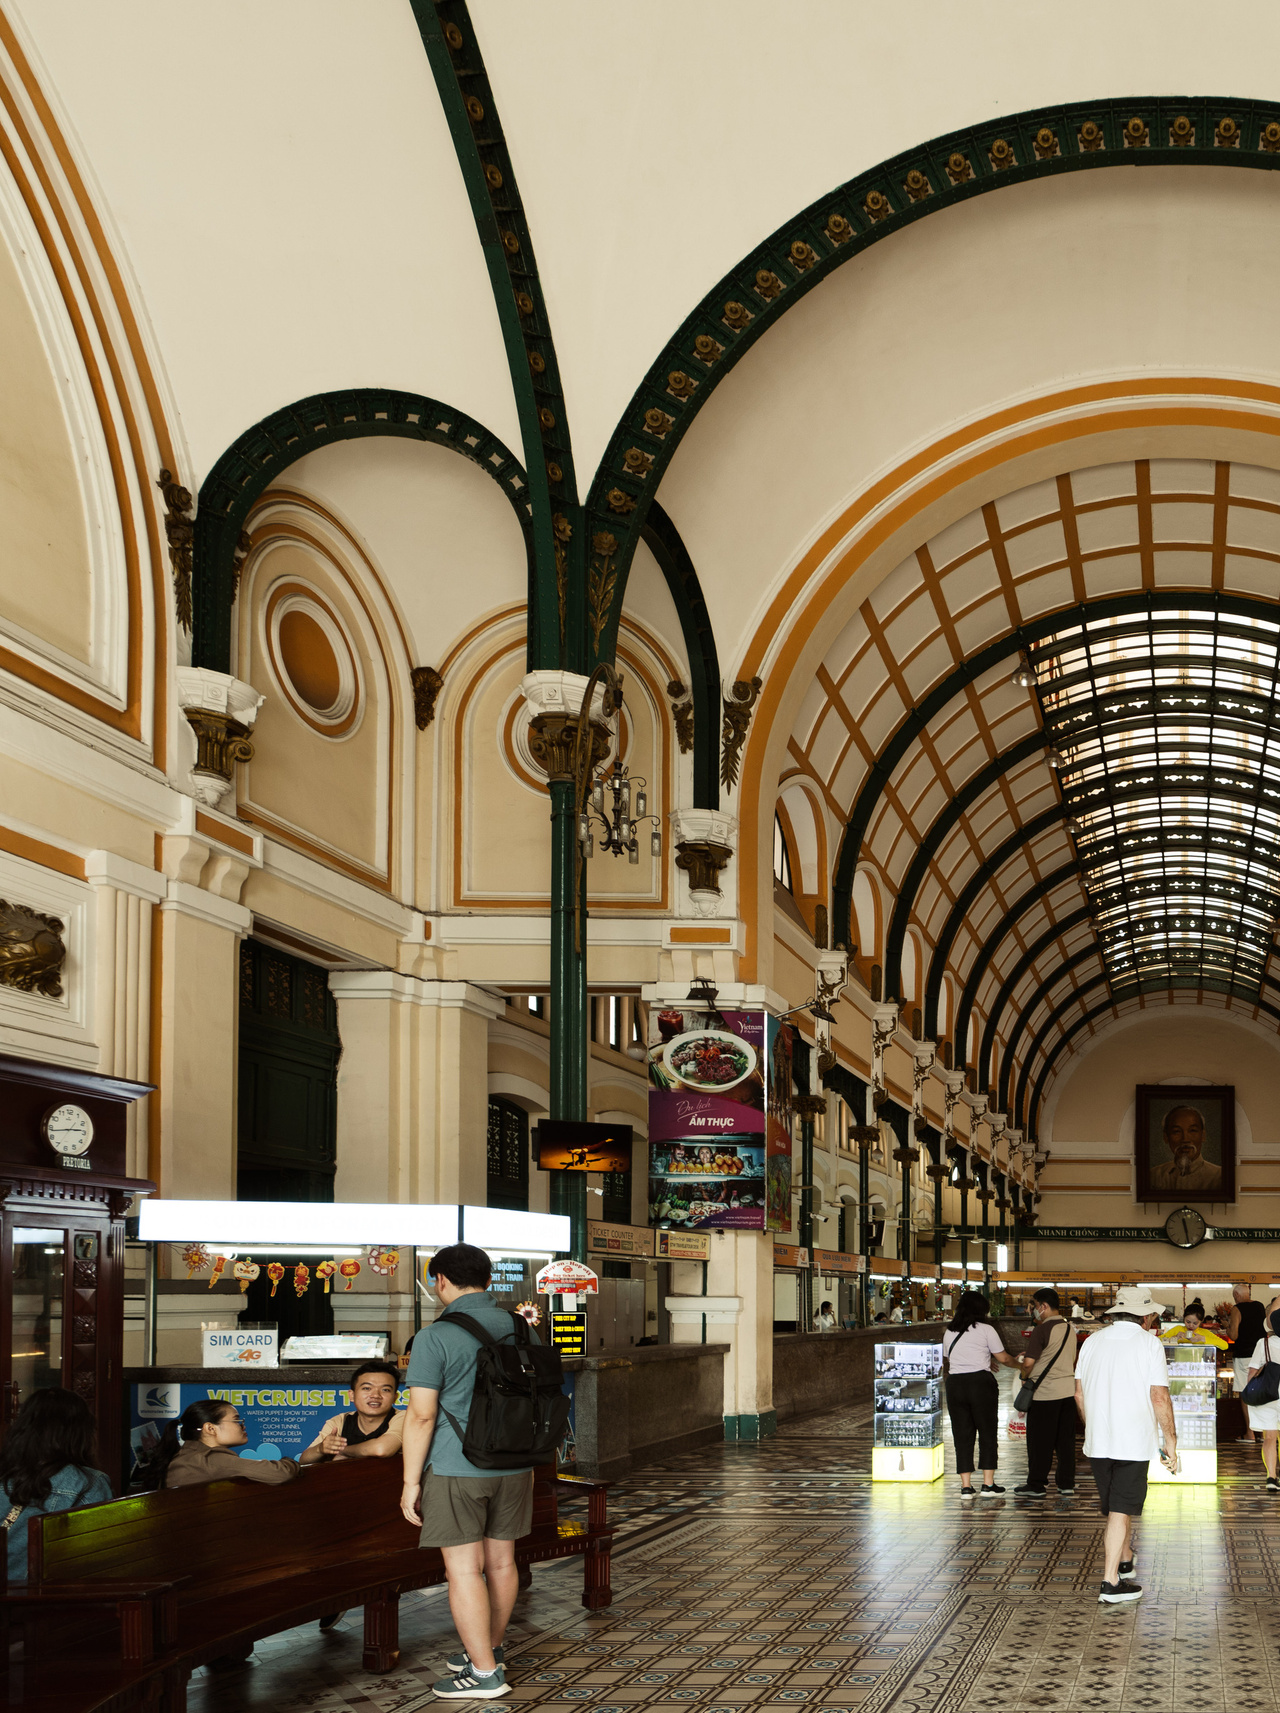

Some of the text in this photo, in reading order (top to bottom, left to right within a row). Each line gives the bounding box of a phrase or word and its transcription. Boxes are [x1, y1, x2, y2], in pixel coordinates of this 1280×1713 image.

[738, 1020, 762, 1034] Vietnam
[688, 1114, 734, 1128] ẨM THỰC
[63, 1156, 90, 1169] PRETORIA
[593, 1228, 634, 1240] TICKET COUNTER
[1109, 1228, 1137, 1237] CHÍNH
[1226, 1229, 1247, 1237] TOÀN
[84, 1238, 93, 1257] 7
[498, 1263, 524, 1271] BOOKING
[210, 1335, 272, 1346] SIM CARD
[238, 1349, 262, 1362] 4G
[207, 1389, 336, 1406] VIETCRUISE
